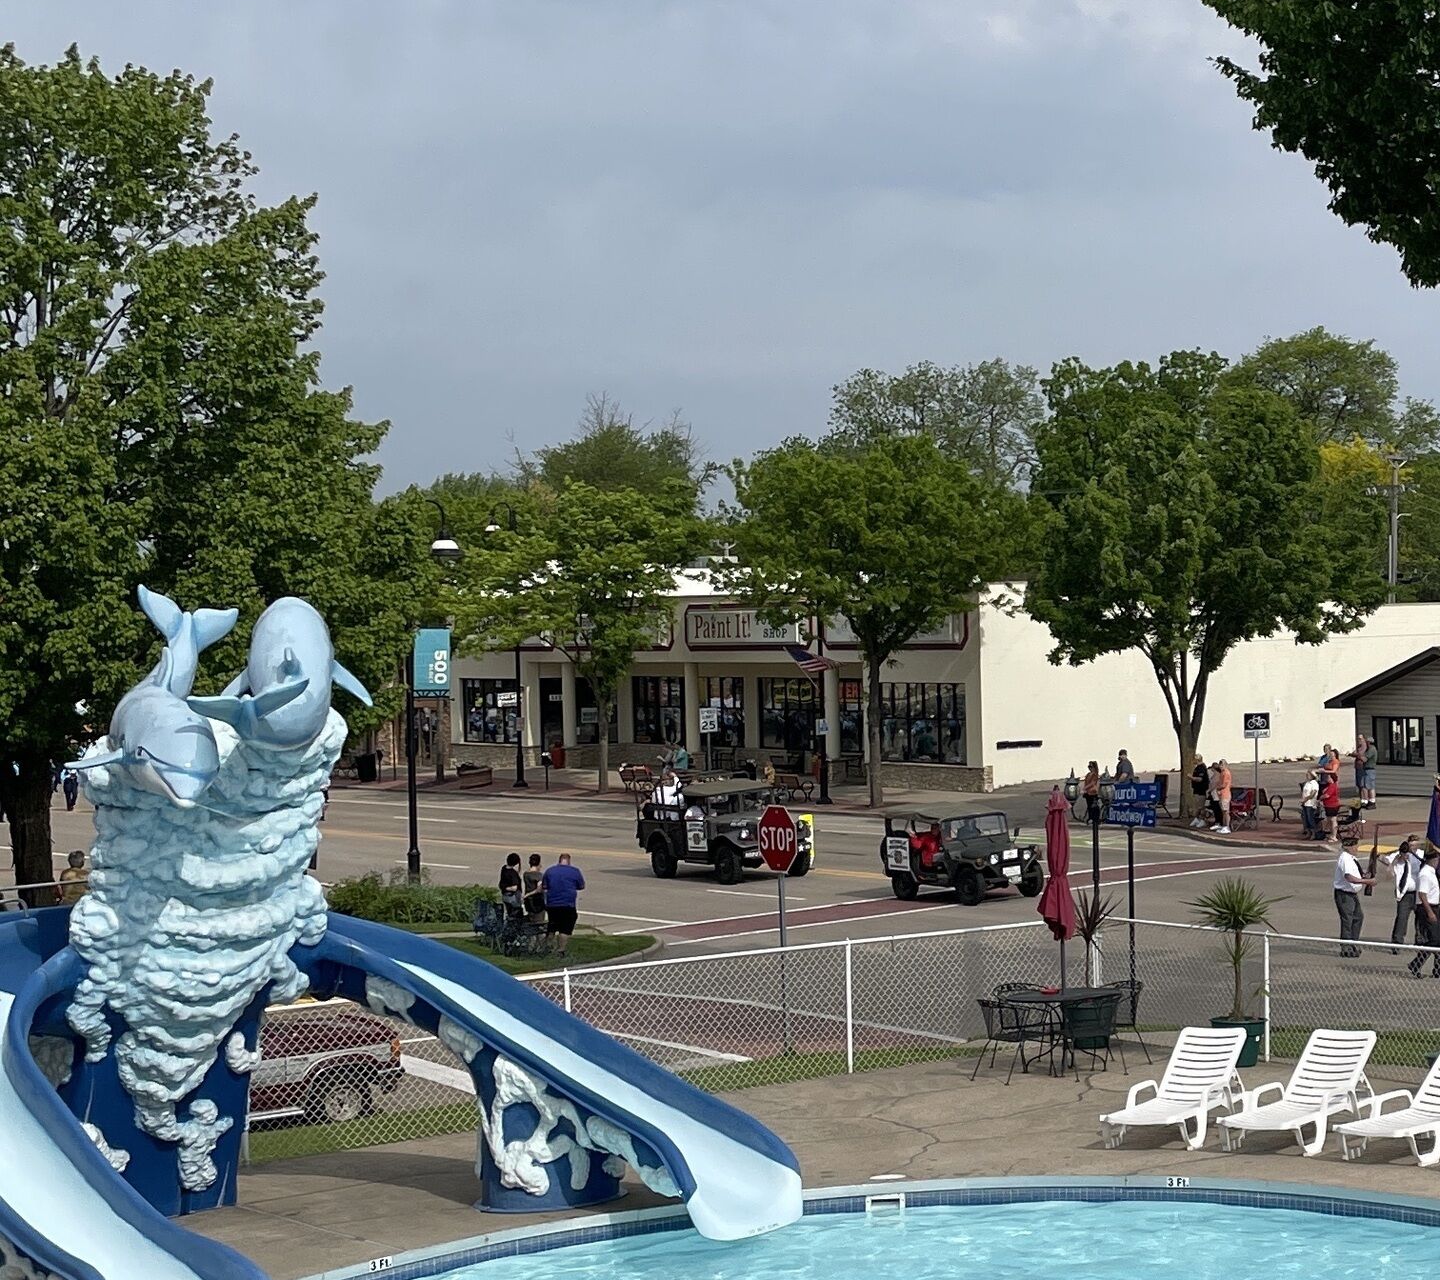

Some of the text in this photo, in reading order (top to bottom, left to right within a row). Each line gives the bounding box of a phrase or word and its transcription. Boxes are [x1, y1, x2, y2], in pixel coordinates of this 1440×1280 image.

[694, 613, 751, 640] Paint It!
[763, 628, 787, 638] SHOP
[434, 649, 448, 684] 500
[701, 720, 716, 730] 25
[761, 826, 794, 852] STOP
[1168, 1178, 1189, 1187] 3 Ft.
[370, 1258, 392, 1272] 3 Ft.
